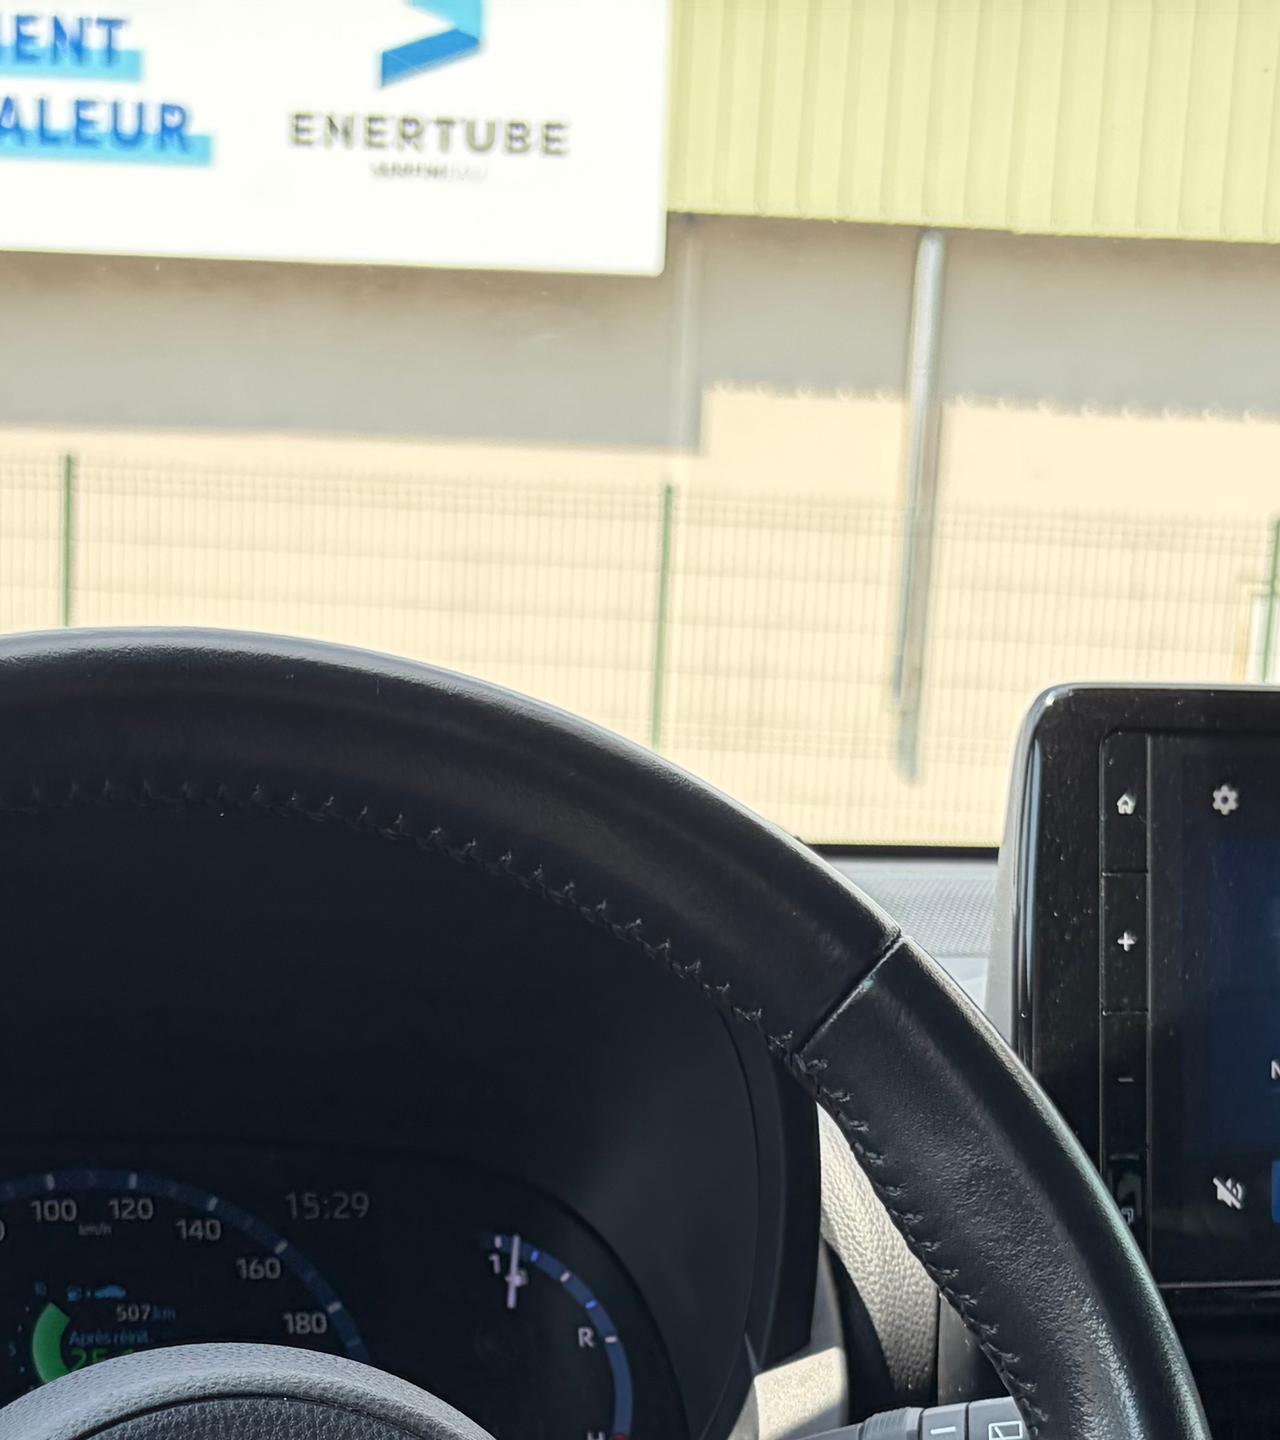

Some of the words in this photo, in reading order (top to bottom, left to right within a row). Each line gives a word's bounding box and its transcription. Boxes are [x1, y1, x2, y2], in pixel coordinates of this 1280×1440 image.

[290, 111, 569, 157] ENERTUBE
[30, 1199, 78, 1222] 100
[108, 1197, 154, 1220] 120
[285, 1192, 370, 1218] 15:29
[176, 1219, 221, 1241] 140
[237, 1258, 281, 1280] 160
[115, 1304, 152, 1322] 507
[283, 1312, 327, 1335] 180
[578, 1327, 595, 1348] R
